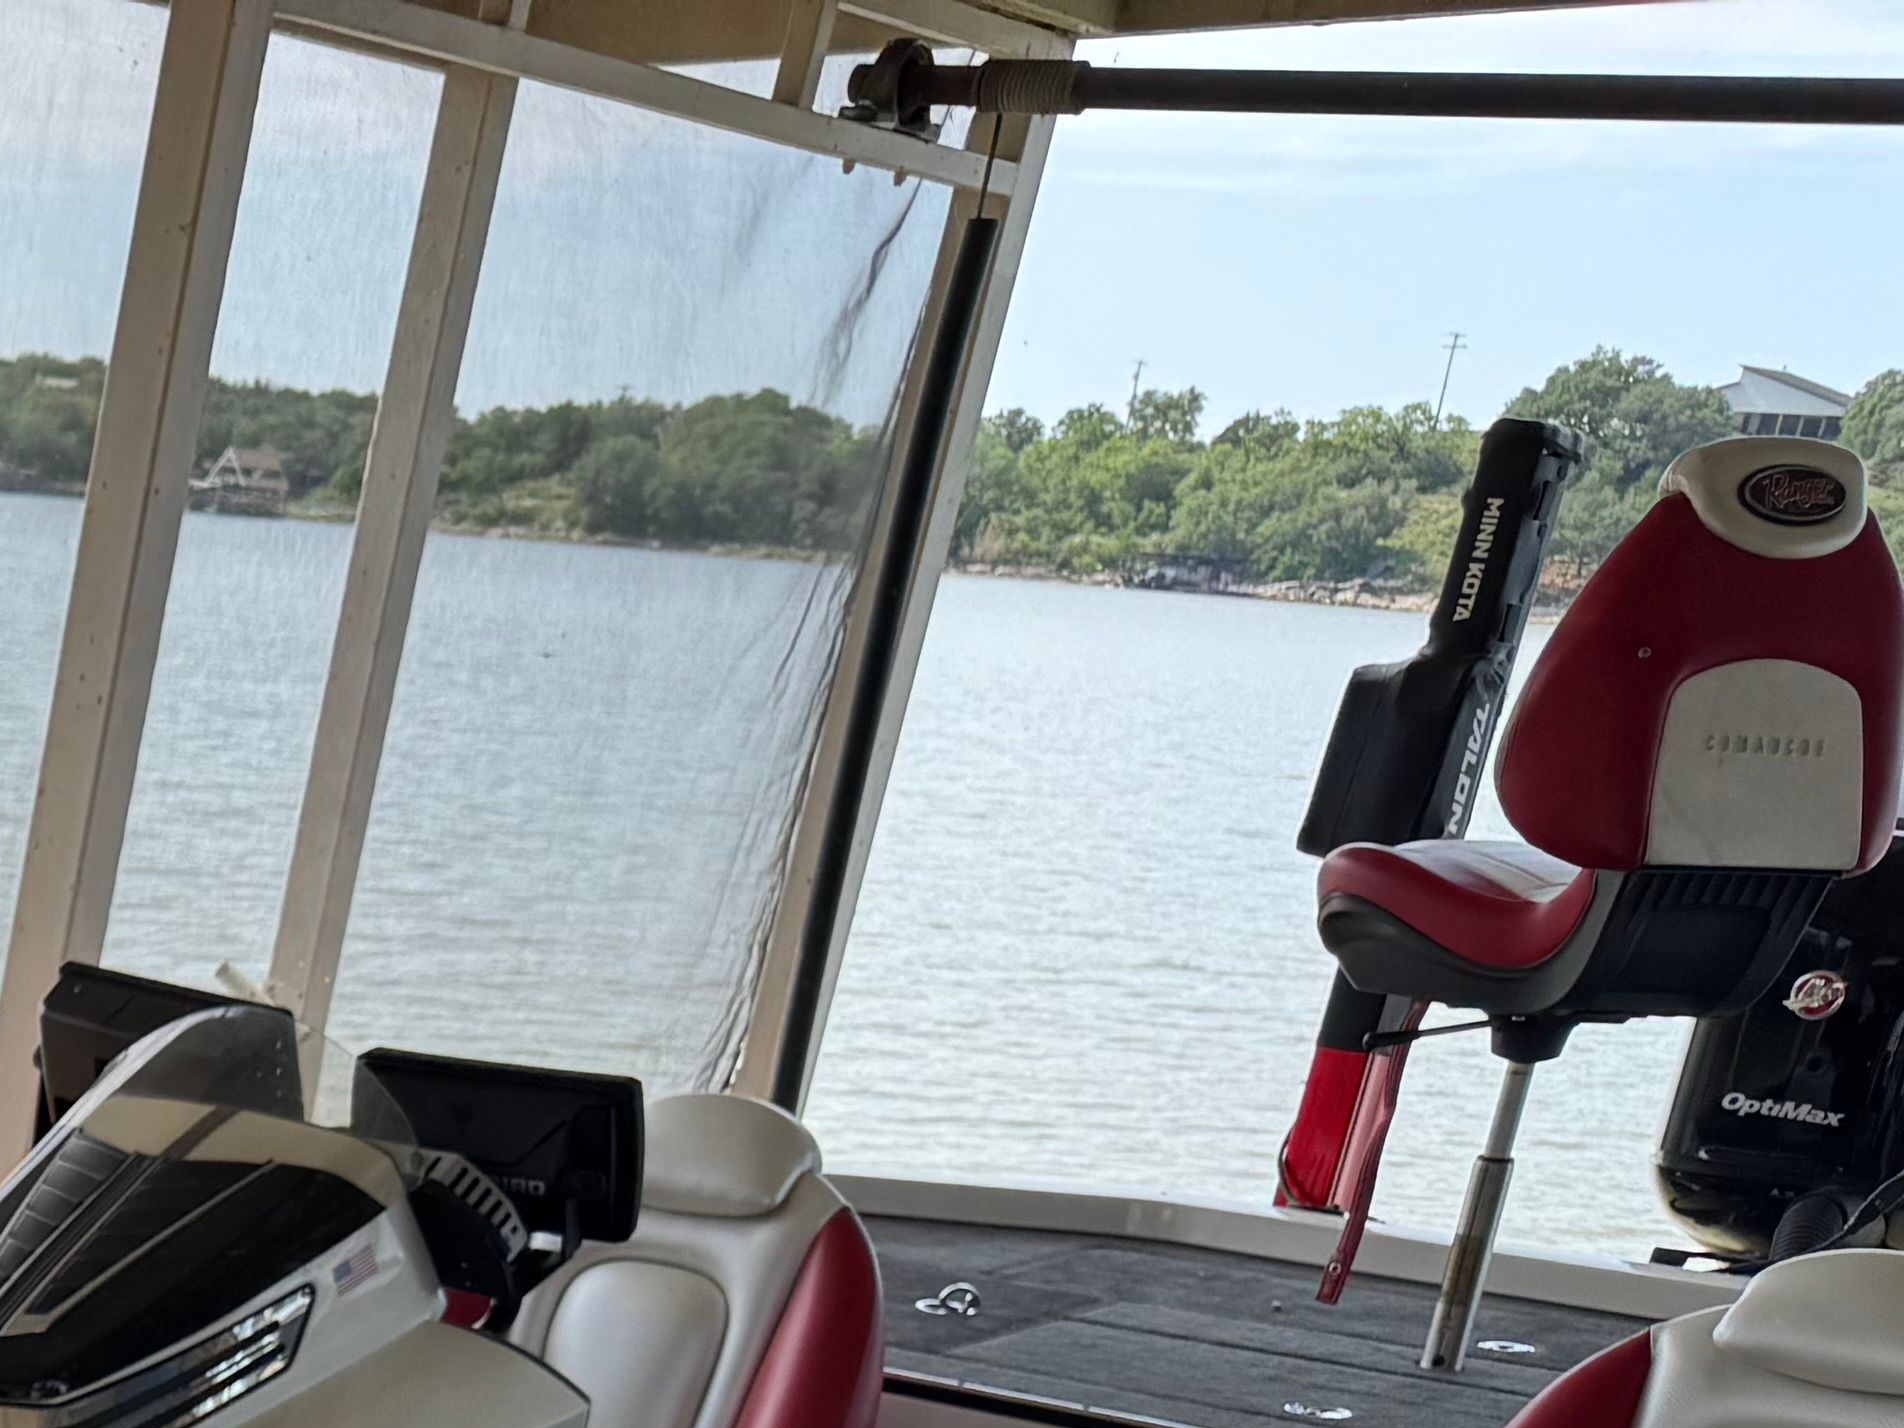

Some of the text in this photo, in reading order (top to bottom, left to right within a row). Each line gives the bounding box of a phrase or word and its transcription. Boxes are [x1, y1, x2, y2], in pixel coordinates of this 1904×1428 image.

[1453, 497, 1505, 622] MINN KOTA
[1447, 703, 1489, 834] TALON
[1721, 1091, 1845, 1128] OptiMax
